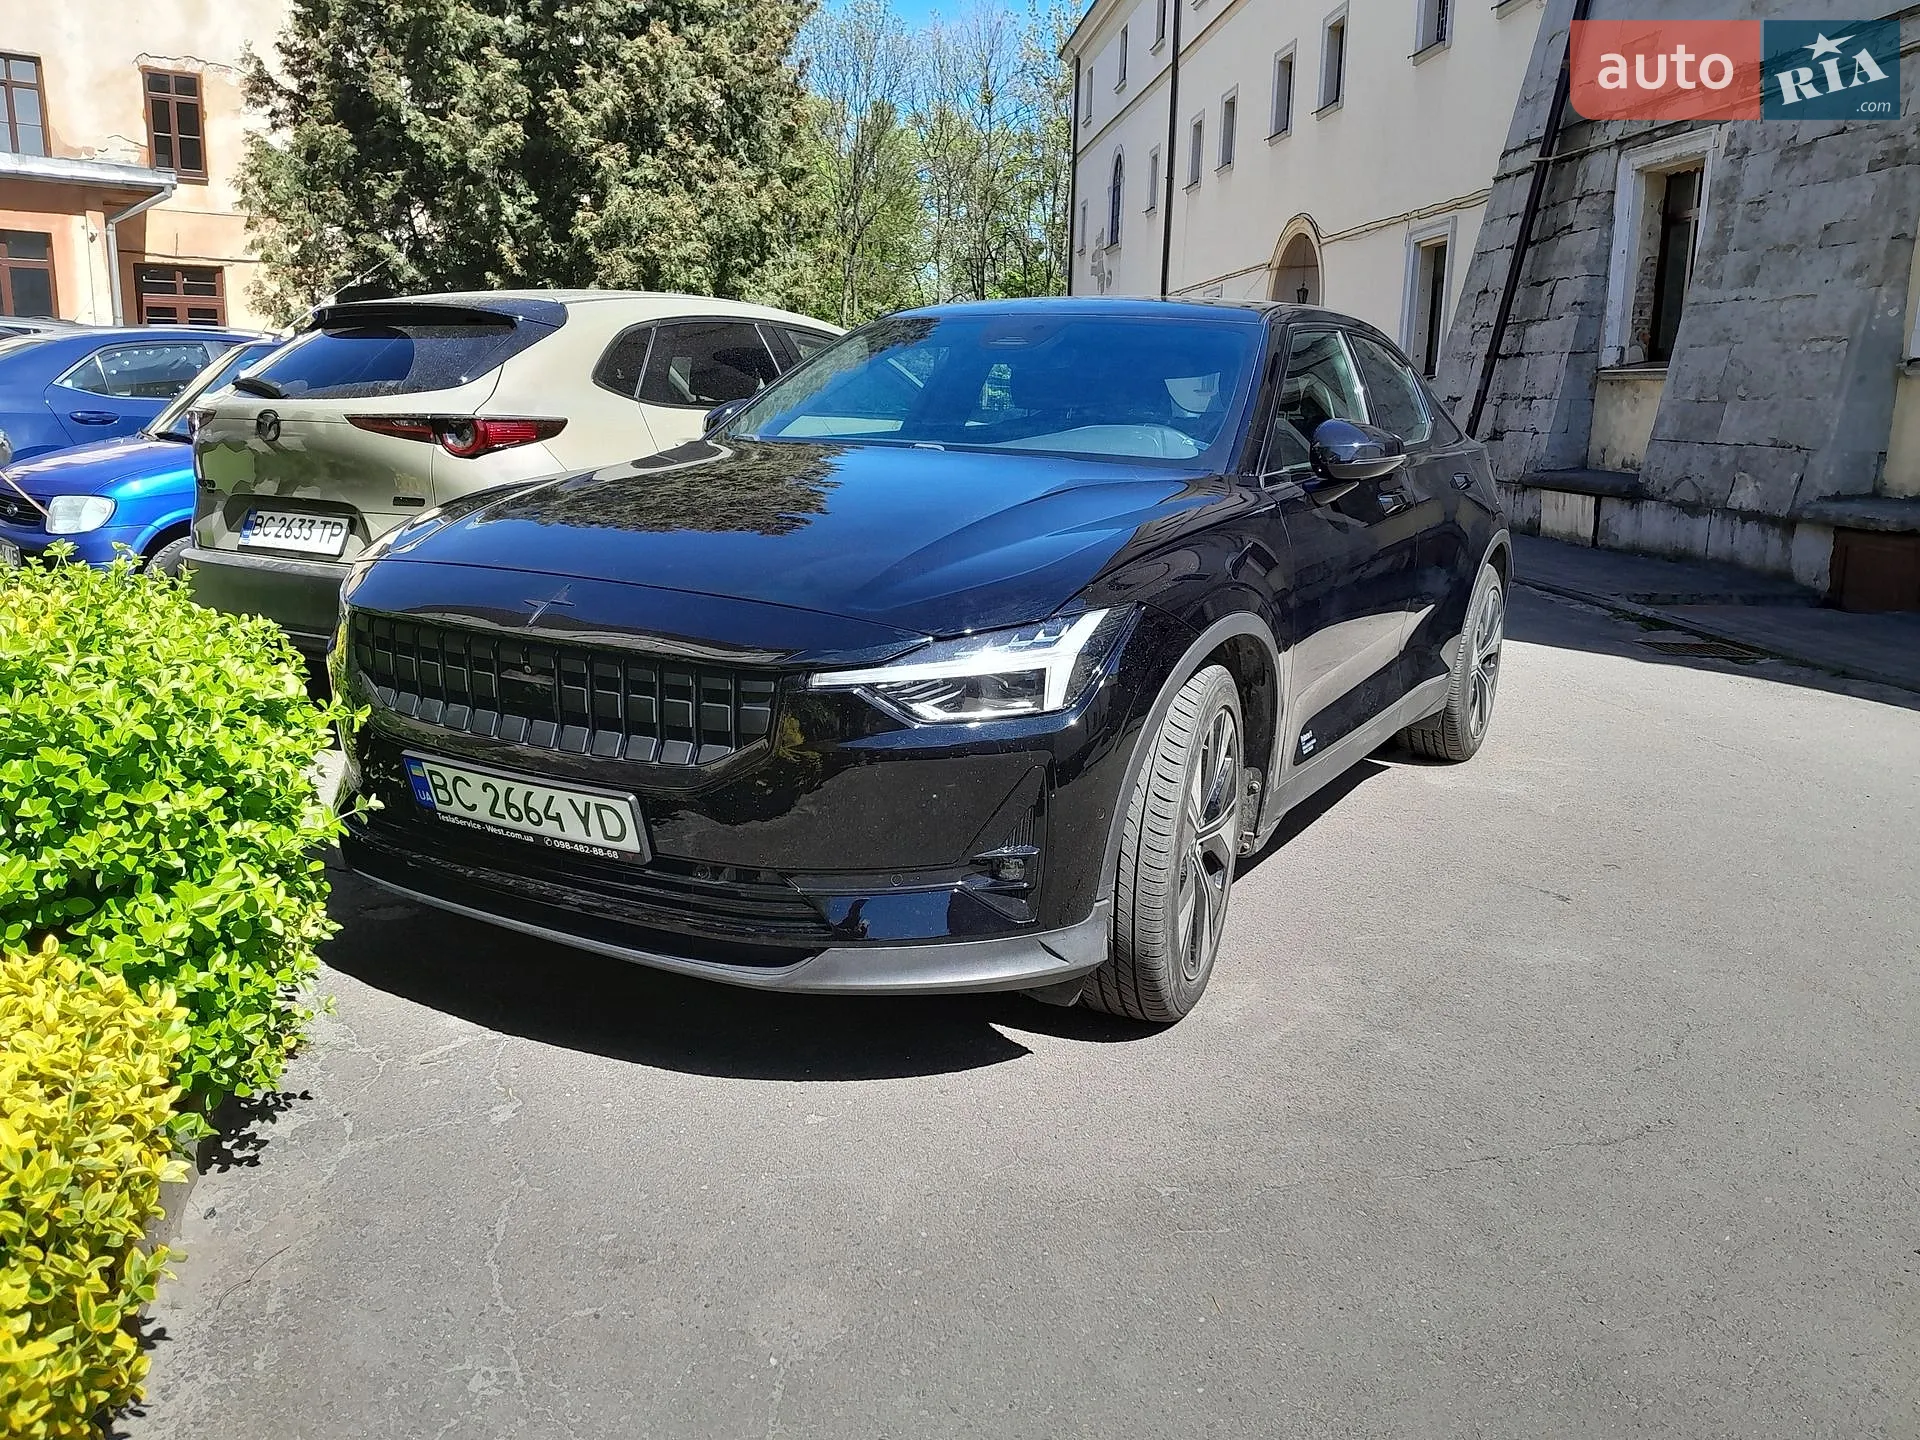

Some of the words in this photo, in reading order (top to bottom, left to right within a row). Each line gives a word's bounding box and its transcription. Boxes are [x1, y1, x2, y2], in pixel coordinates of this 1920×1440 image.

[251, 515, 276, 538] BC
[273, 517, 316, 541] 2633
[319, 520, 344, 545] TP
[417, 788, 434, 803] UA
[427, 768, 478, 812] BC
[481, 782, 567, 833] 2664
[568, 798, 627, 843] YD
[553, 839, 620, 860] 098-482-88-68
